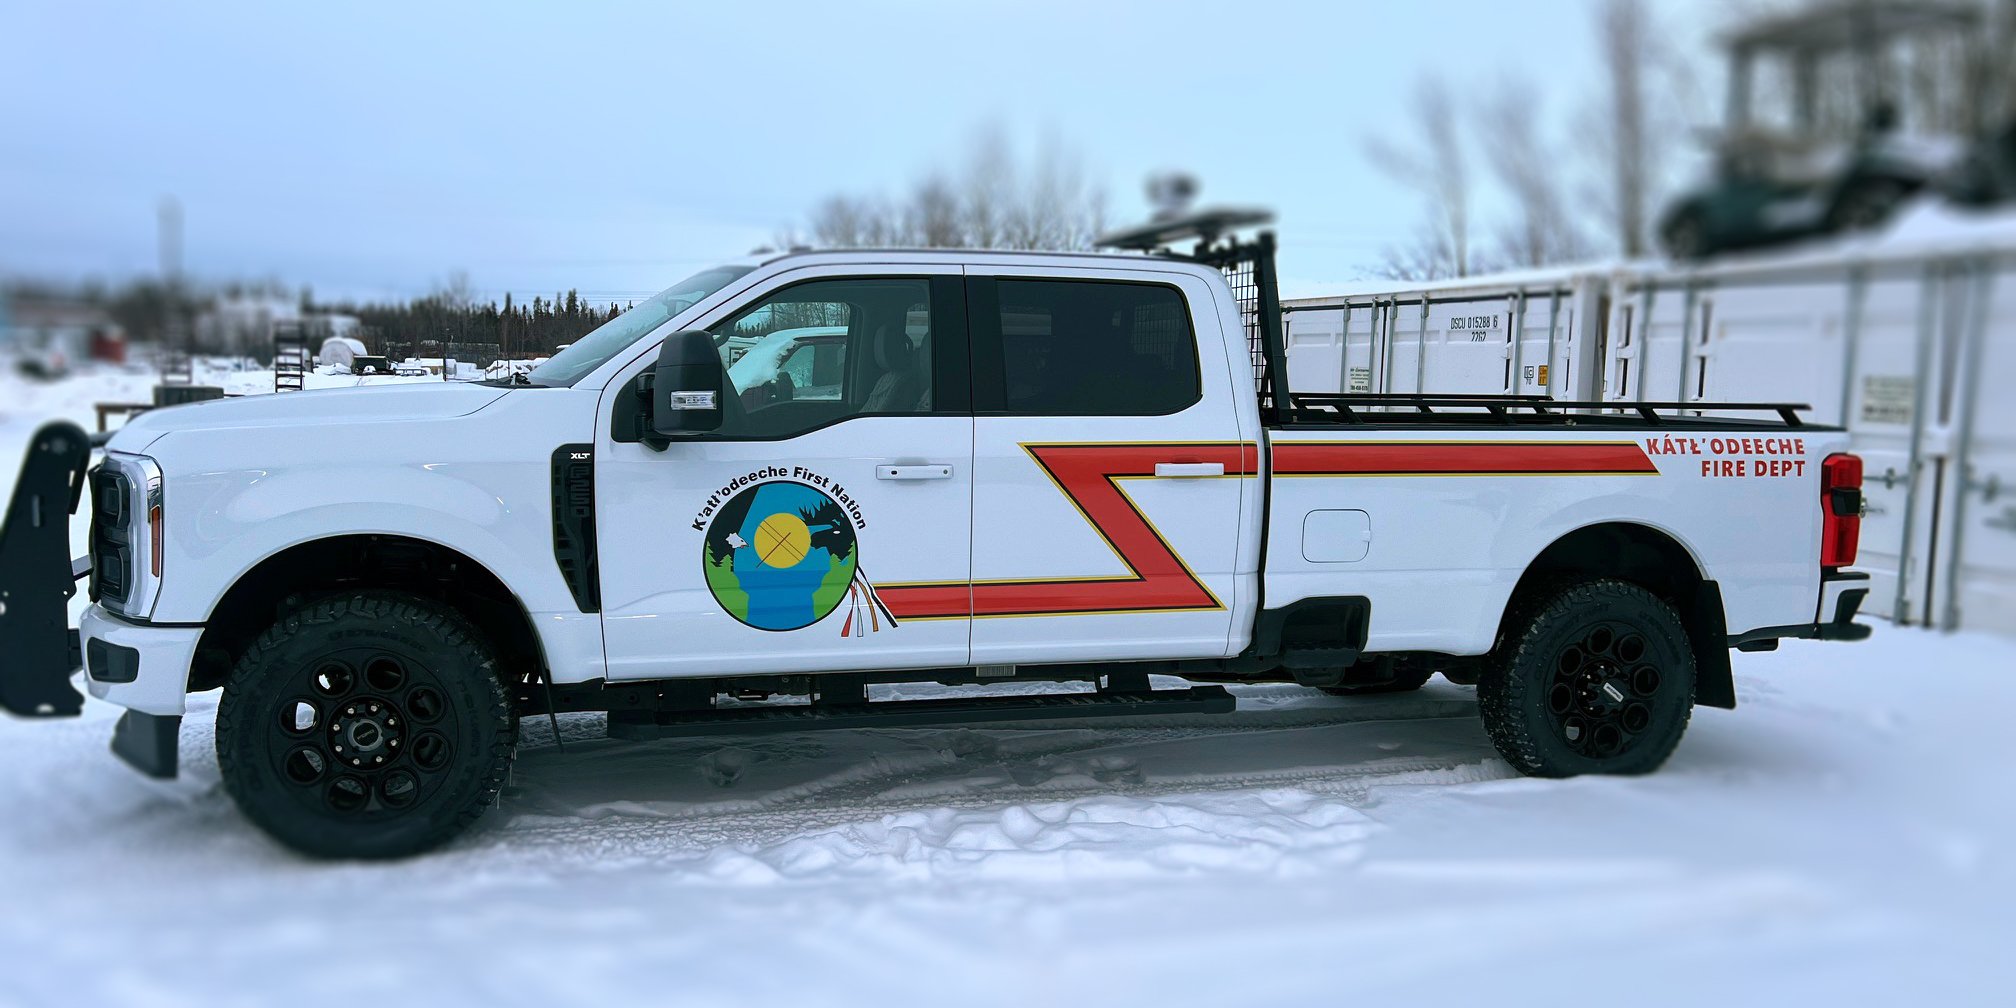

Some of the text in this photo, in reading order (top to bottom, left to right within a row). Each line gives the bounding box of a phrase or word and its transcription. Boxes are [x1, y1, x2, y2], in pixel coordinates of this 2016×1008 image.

[1467, 316, 1491, 329] 015288
[570, 452, 591, 460] XLT
[1701, 460, 1806, 477] FIRE DEPT
[793, 466, 830, 488] First
[830, 483, 867, 530] Nation
